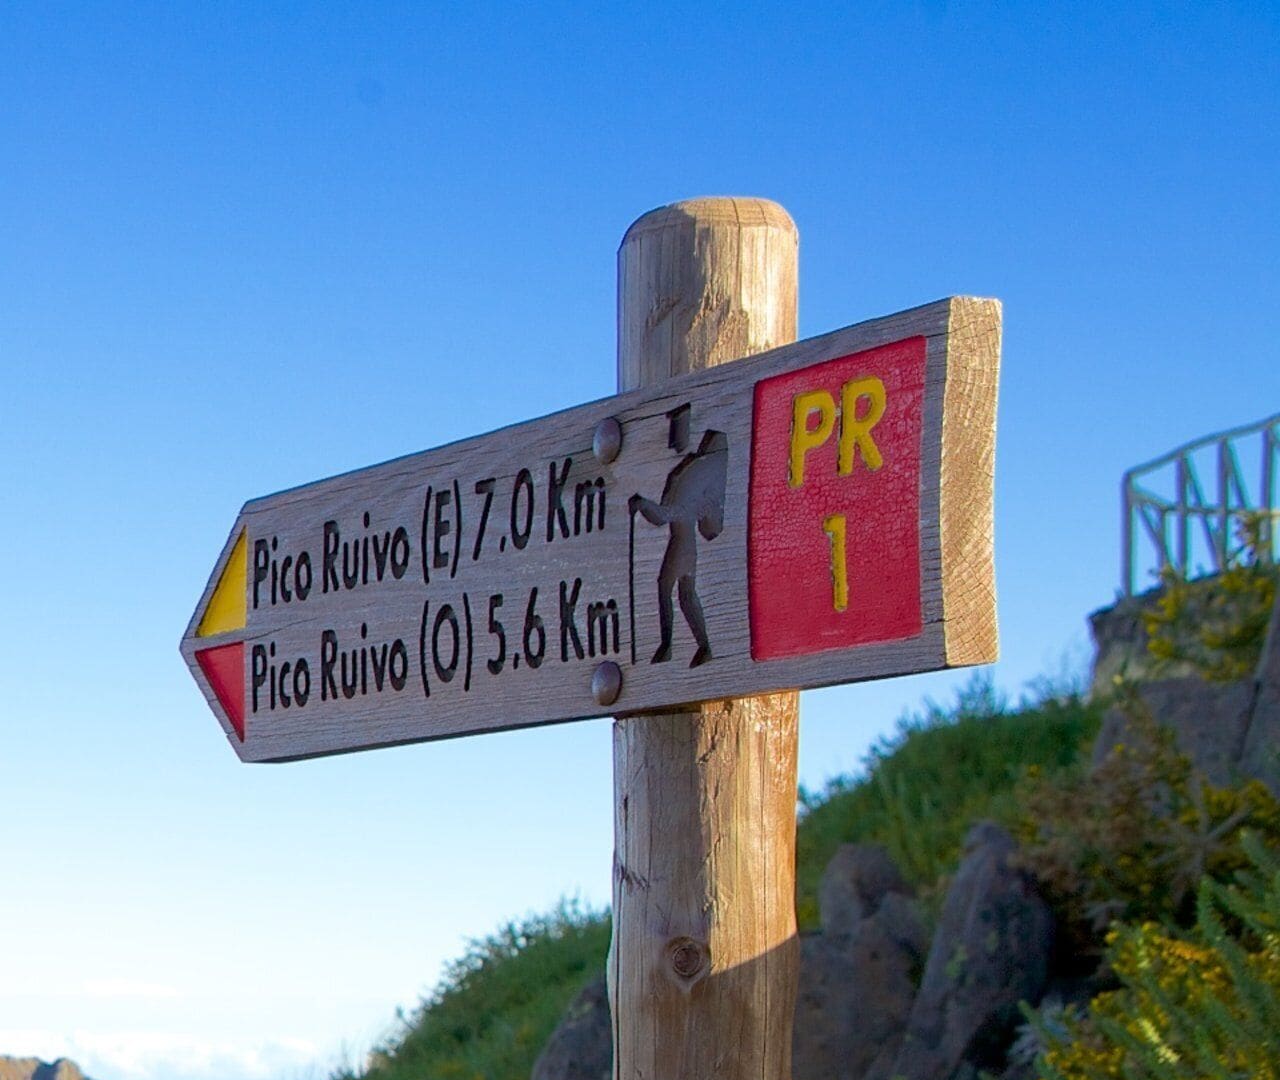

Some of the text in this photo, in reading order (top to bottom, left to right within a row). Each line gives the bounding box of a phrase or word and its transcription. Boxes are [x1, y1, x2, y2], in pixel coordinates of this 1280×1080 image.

[789, 376, 887, 489] PR
[252, 456, 607, 609] Pico Ruivo (E) 7.0 Km
[824, 515, 849, 612] 1
[251, 577, 621, 713] Pico Ruivo (O) 5.6 Km
